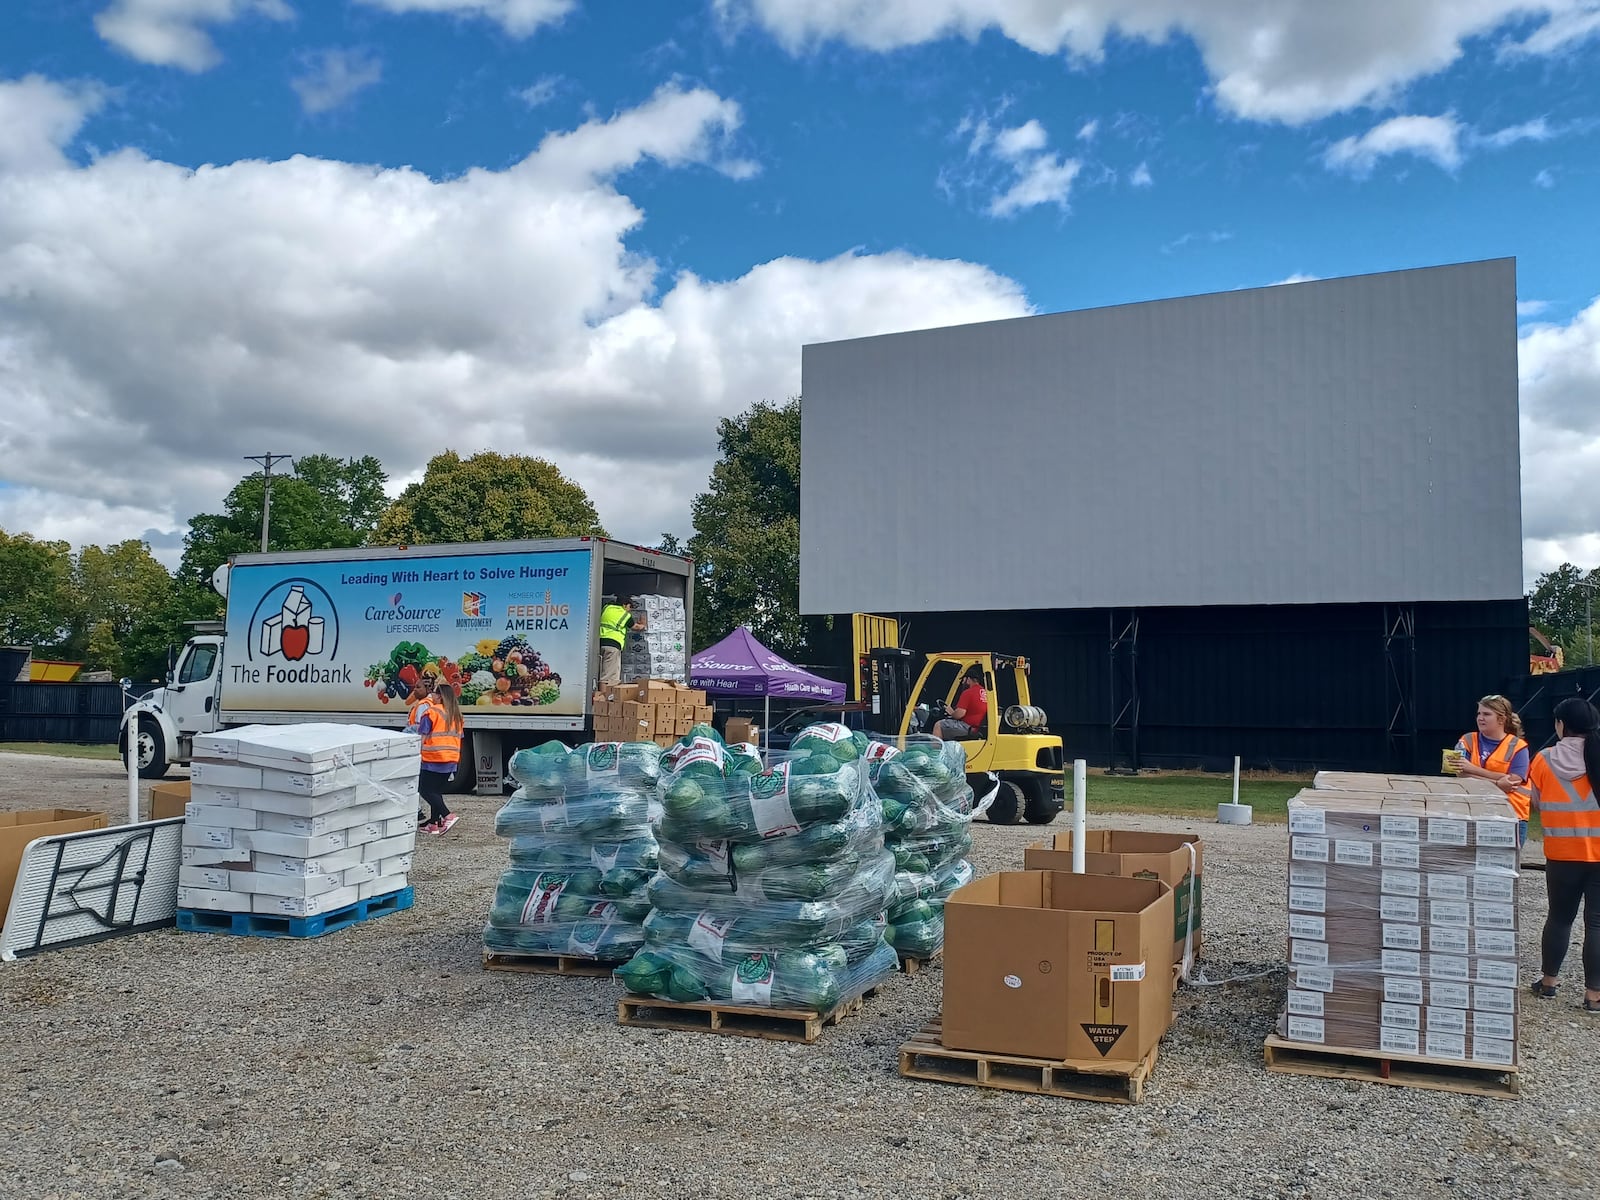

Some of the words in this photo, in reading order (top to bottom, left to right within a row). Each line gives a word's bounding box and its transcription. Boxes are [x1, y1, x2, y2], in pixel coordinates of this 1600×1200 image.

[341, 573, 388, 586] Leading
[391, 571, 419, 583] With
[423, 570, 459, 582] Heart
[462, 569, 476, 580] to
[479, 567, 516, 580] Solve
[519, 566, 569, 580] Hunger
[535, 591, 545, 599] OF
[365, 605, 441, 621] CareSource
[507, 605, 569, 617] FEEDING
[386, 624, 402, 634] LIFE
[402, 623, 440, 633] SERVICES
[456, 618, 492, 628] MONTGOMERY
[505, 618, 569, 631] AMERICA
[231, 664, 260, 683] The
[266, 664, 352, 683] Foodbank
[700, 679, 715, 687] with
[716, 680, 739, 688] Heart
[784, 683, 799, 691] Health
[800, 683, 810, 692] Care
[811, 685, 820, 693] with
[820, 685, 832, 695] Heart
[1089, 1027, 1119, 1035] WATCH
